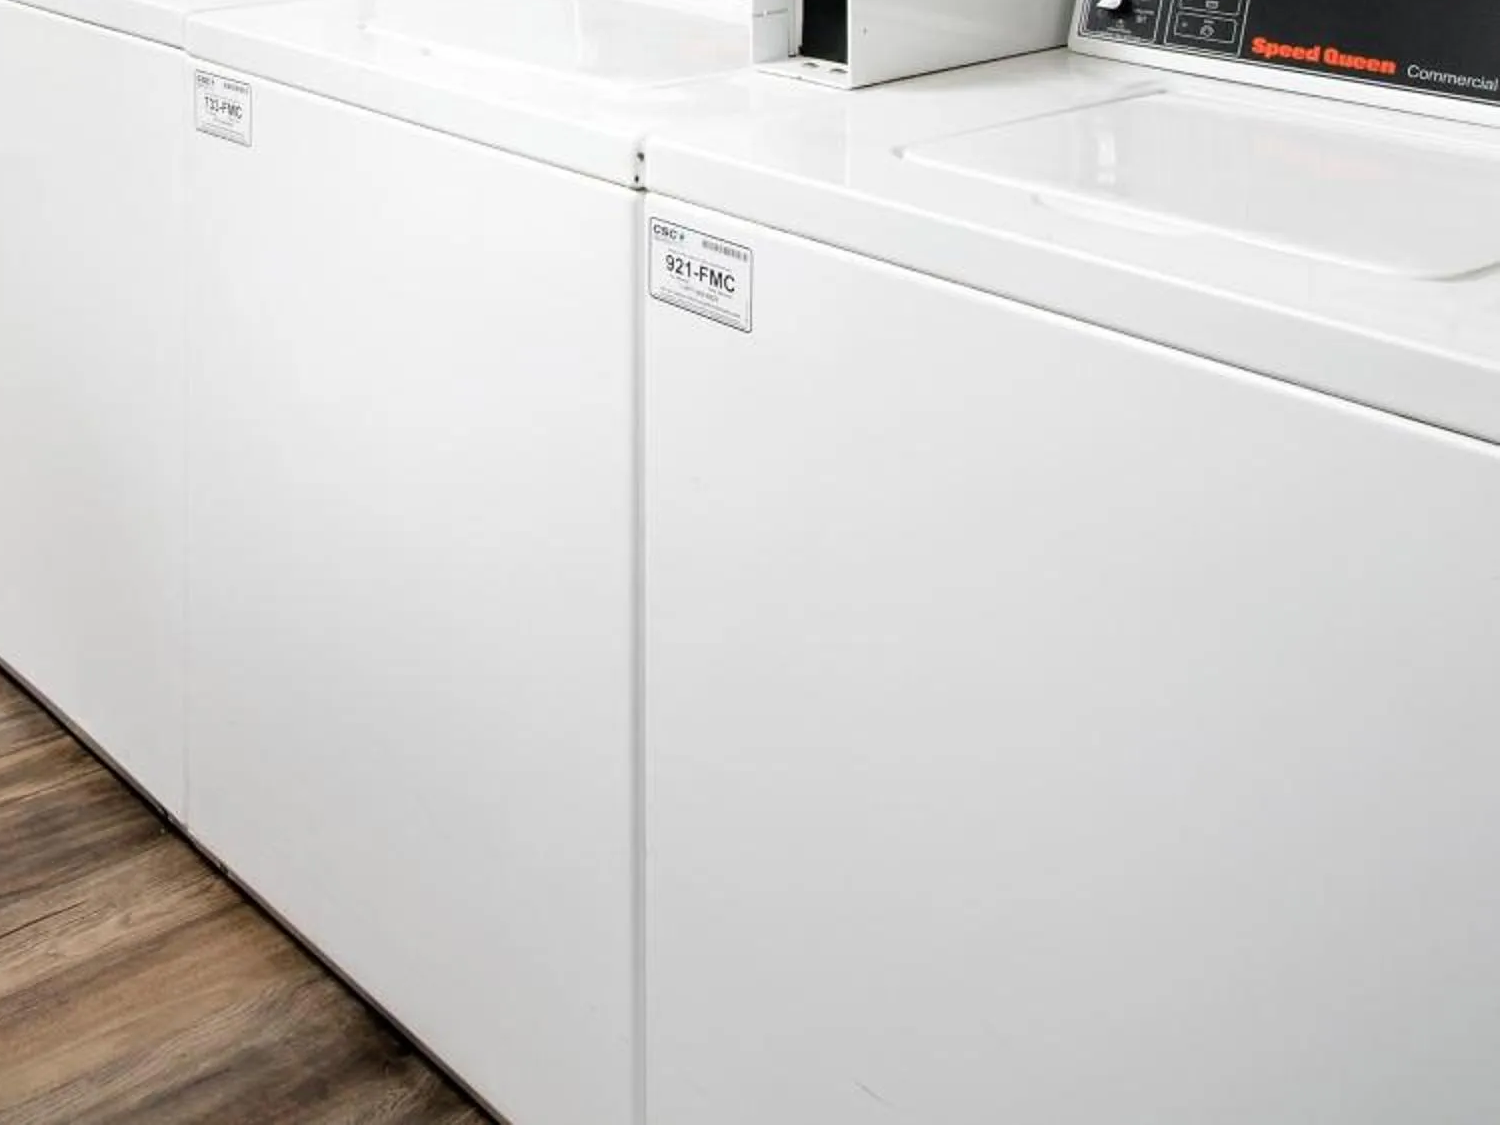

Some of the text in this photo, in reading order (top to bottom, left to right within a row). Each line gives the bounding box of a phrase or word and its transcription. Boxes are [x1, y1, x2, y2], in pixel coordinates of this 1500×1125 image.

[1251, 37, 1499, 93] Speed Queen Commercial
[665, 254, 736, 294] 921-FMC
